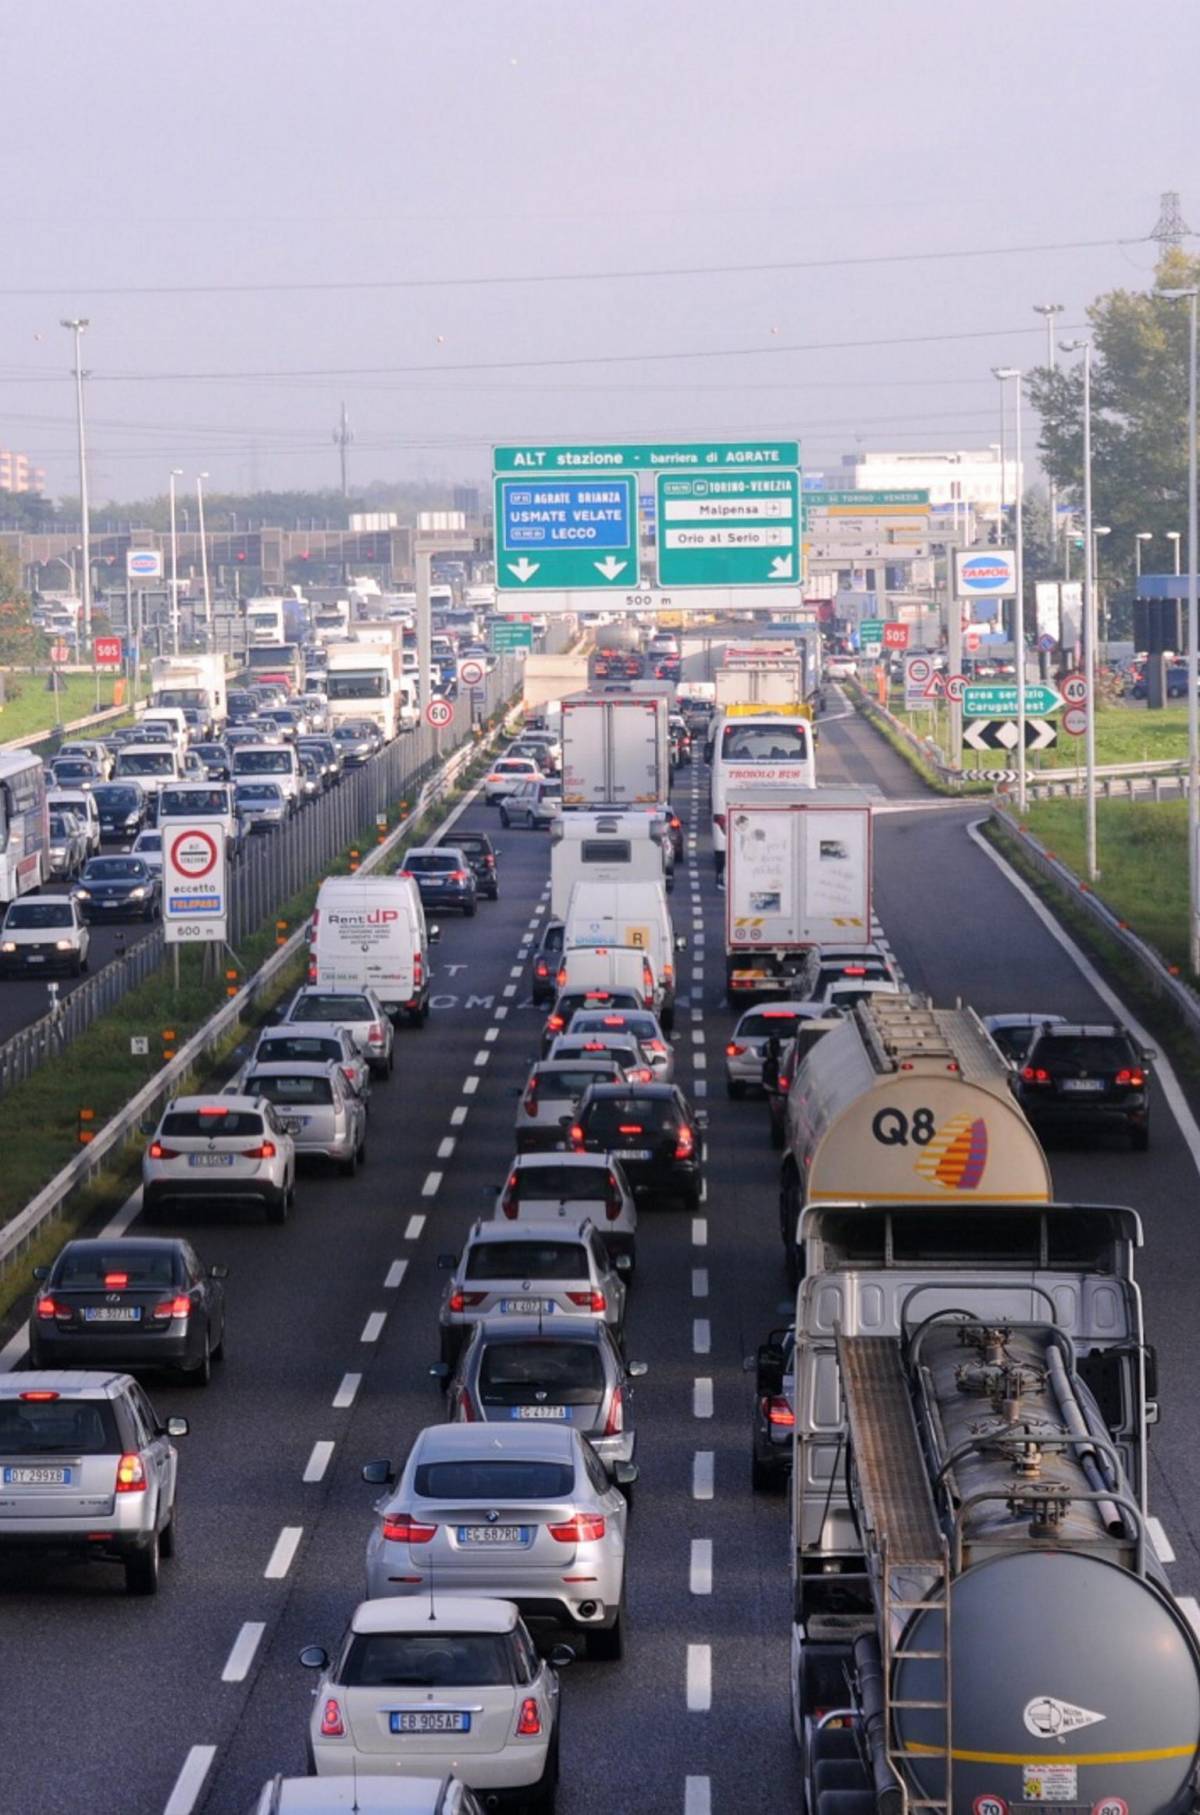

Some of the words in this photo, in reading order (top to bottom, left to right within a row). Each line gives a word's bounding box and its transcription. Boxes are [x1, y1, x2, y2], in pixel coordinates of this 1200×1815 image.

[513, 451, 546, 466] ALT
[556, 450, 624, 465] stazione
[650, 452, 698, 464] barriera
[706, 451, 718, 463] di
[726, 450, 780, 463] AGRATE
[534, 493, 571, 505] AGRATE
[577, 491, 621, 504] BRIANZA
[510, 511, 567, 523] USMATE
[572, 509, 622, 522] VELATE
[699, 504, 759, 517] Malpensa
[551, 528, 597, 540] LECCO
[678, 534, 704, 544] Orio
[710, 533, 721, 543] al
[727, 532, 760, 543] Serio
[626, 596, 652, 606] 500
[661, 597, 672, 605] m
[886, 629, 907, 642] SOS
[97, 645, 119, 657] SOS
[967, 689, 992, 699] area
[1067, 683, 1086, 698] 40
[431, 707, 447, 719] 60
[173, 883, 216, 893] eccetto
[177, 926, 200, 936] 600
[632, 932, 643, 944] R
[872, 1107, 936, 1146] Q8
[400, 1713, 416, 1729] EB
[420, 1713, 460, 1729] 905AF
